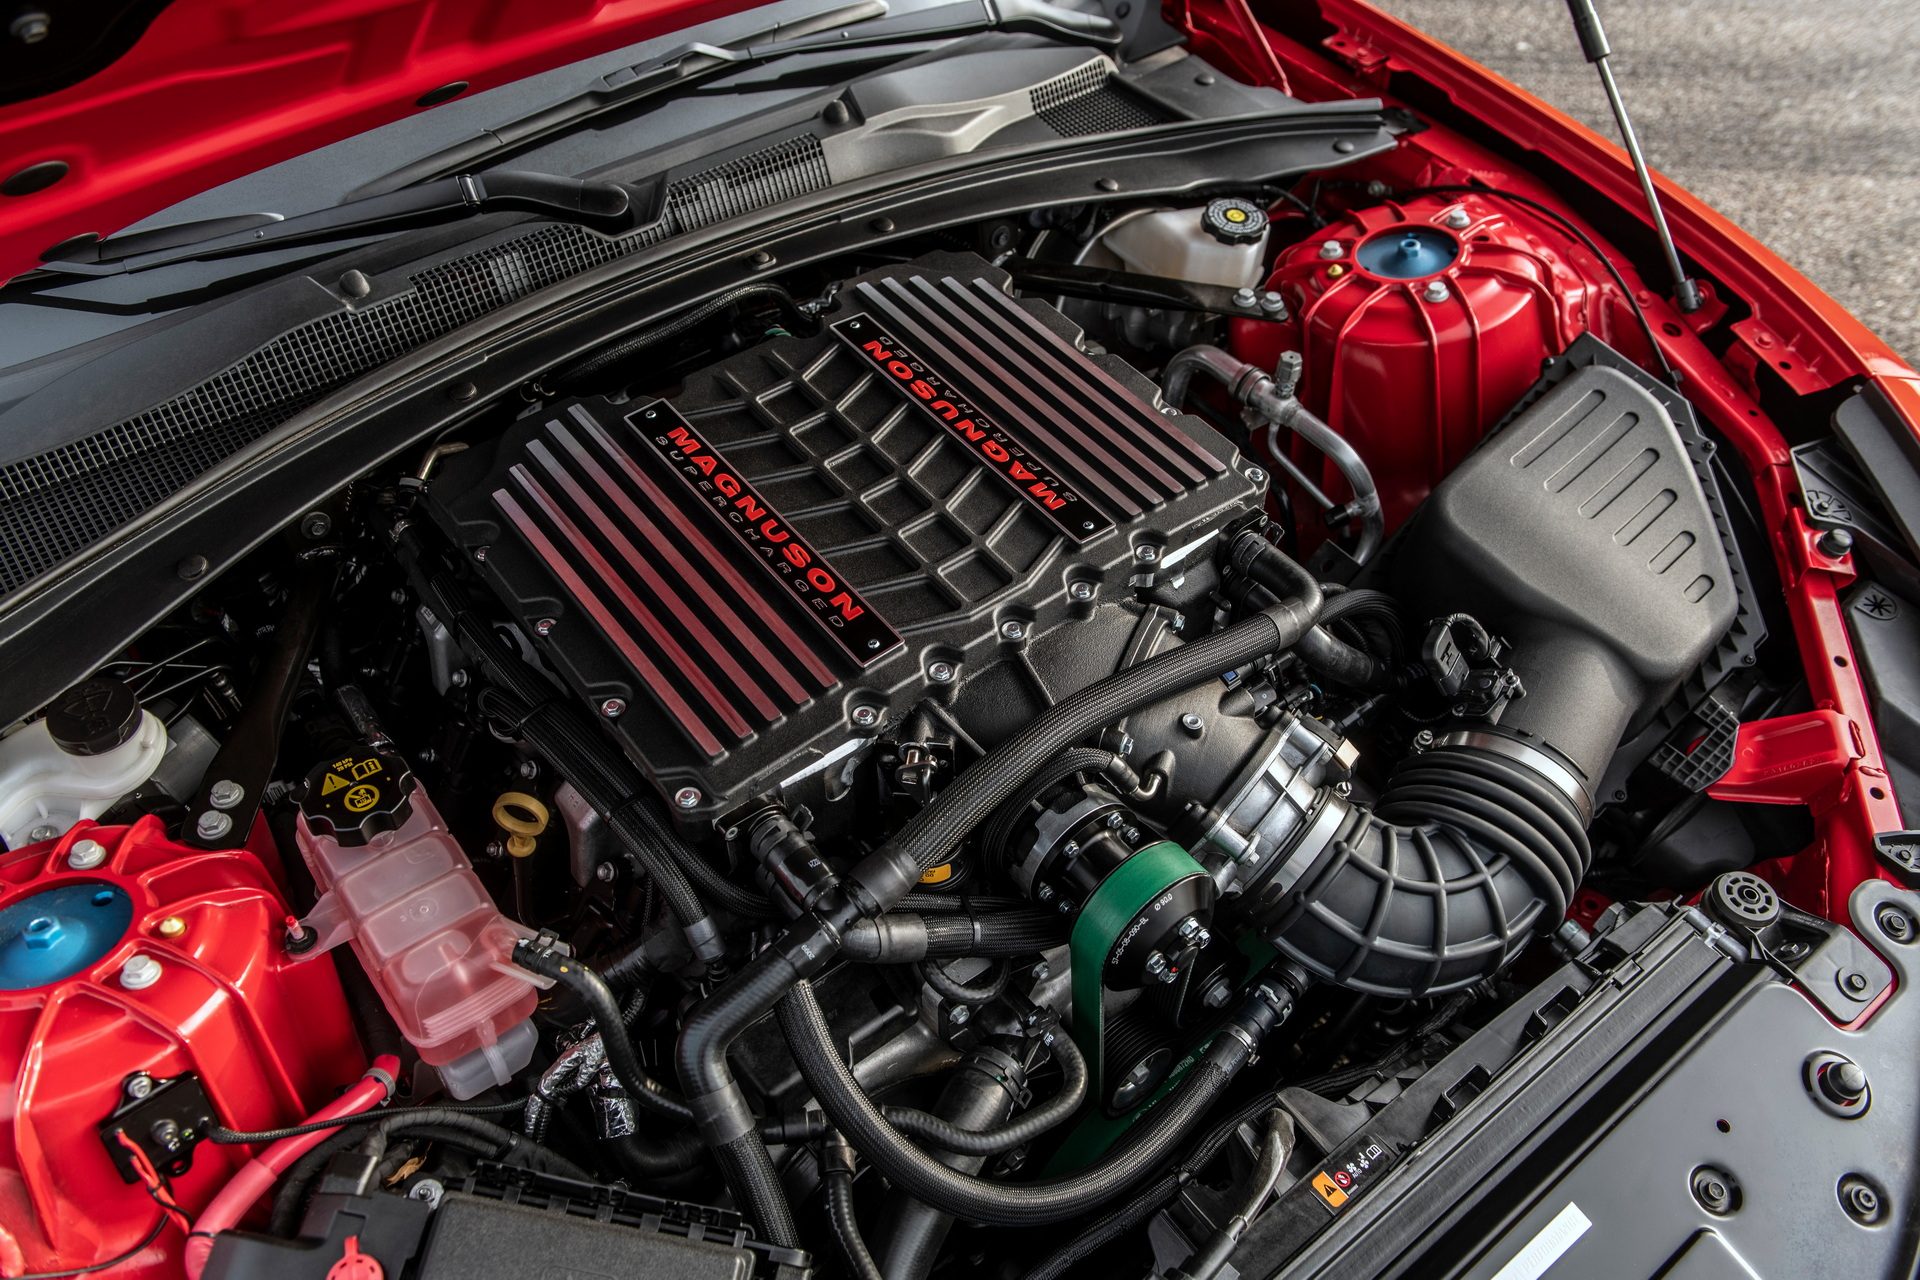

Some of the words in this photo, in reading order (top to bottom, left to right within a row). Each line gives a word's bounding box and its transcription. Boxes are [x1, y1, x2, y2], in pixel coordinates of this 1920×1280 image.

[862, 340, 1067, 511] MAGNUSON
[879, 336, 1078, 502] SUPERCHARGED
[655, 435, 844, 628] SUPERCHARGED
[666, 426, 864, 621] MAGNUSON
